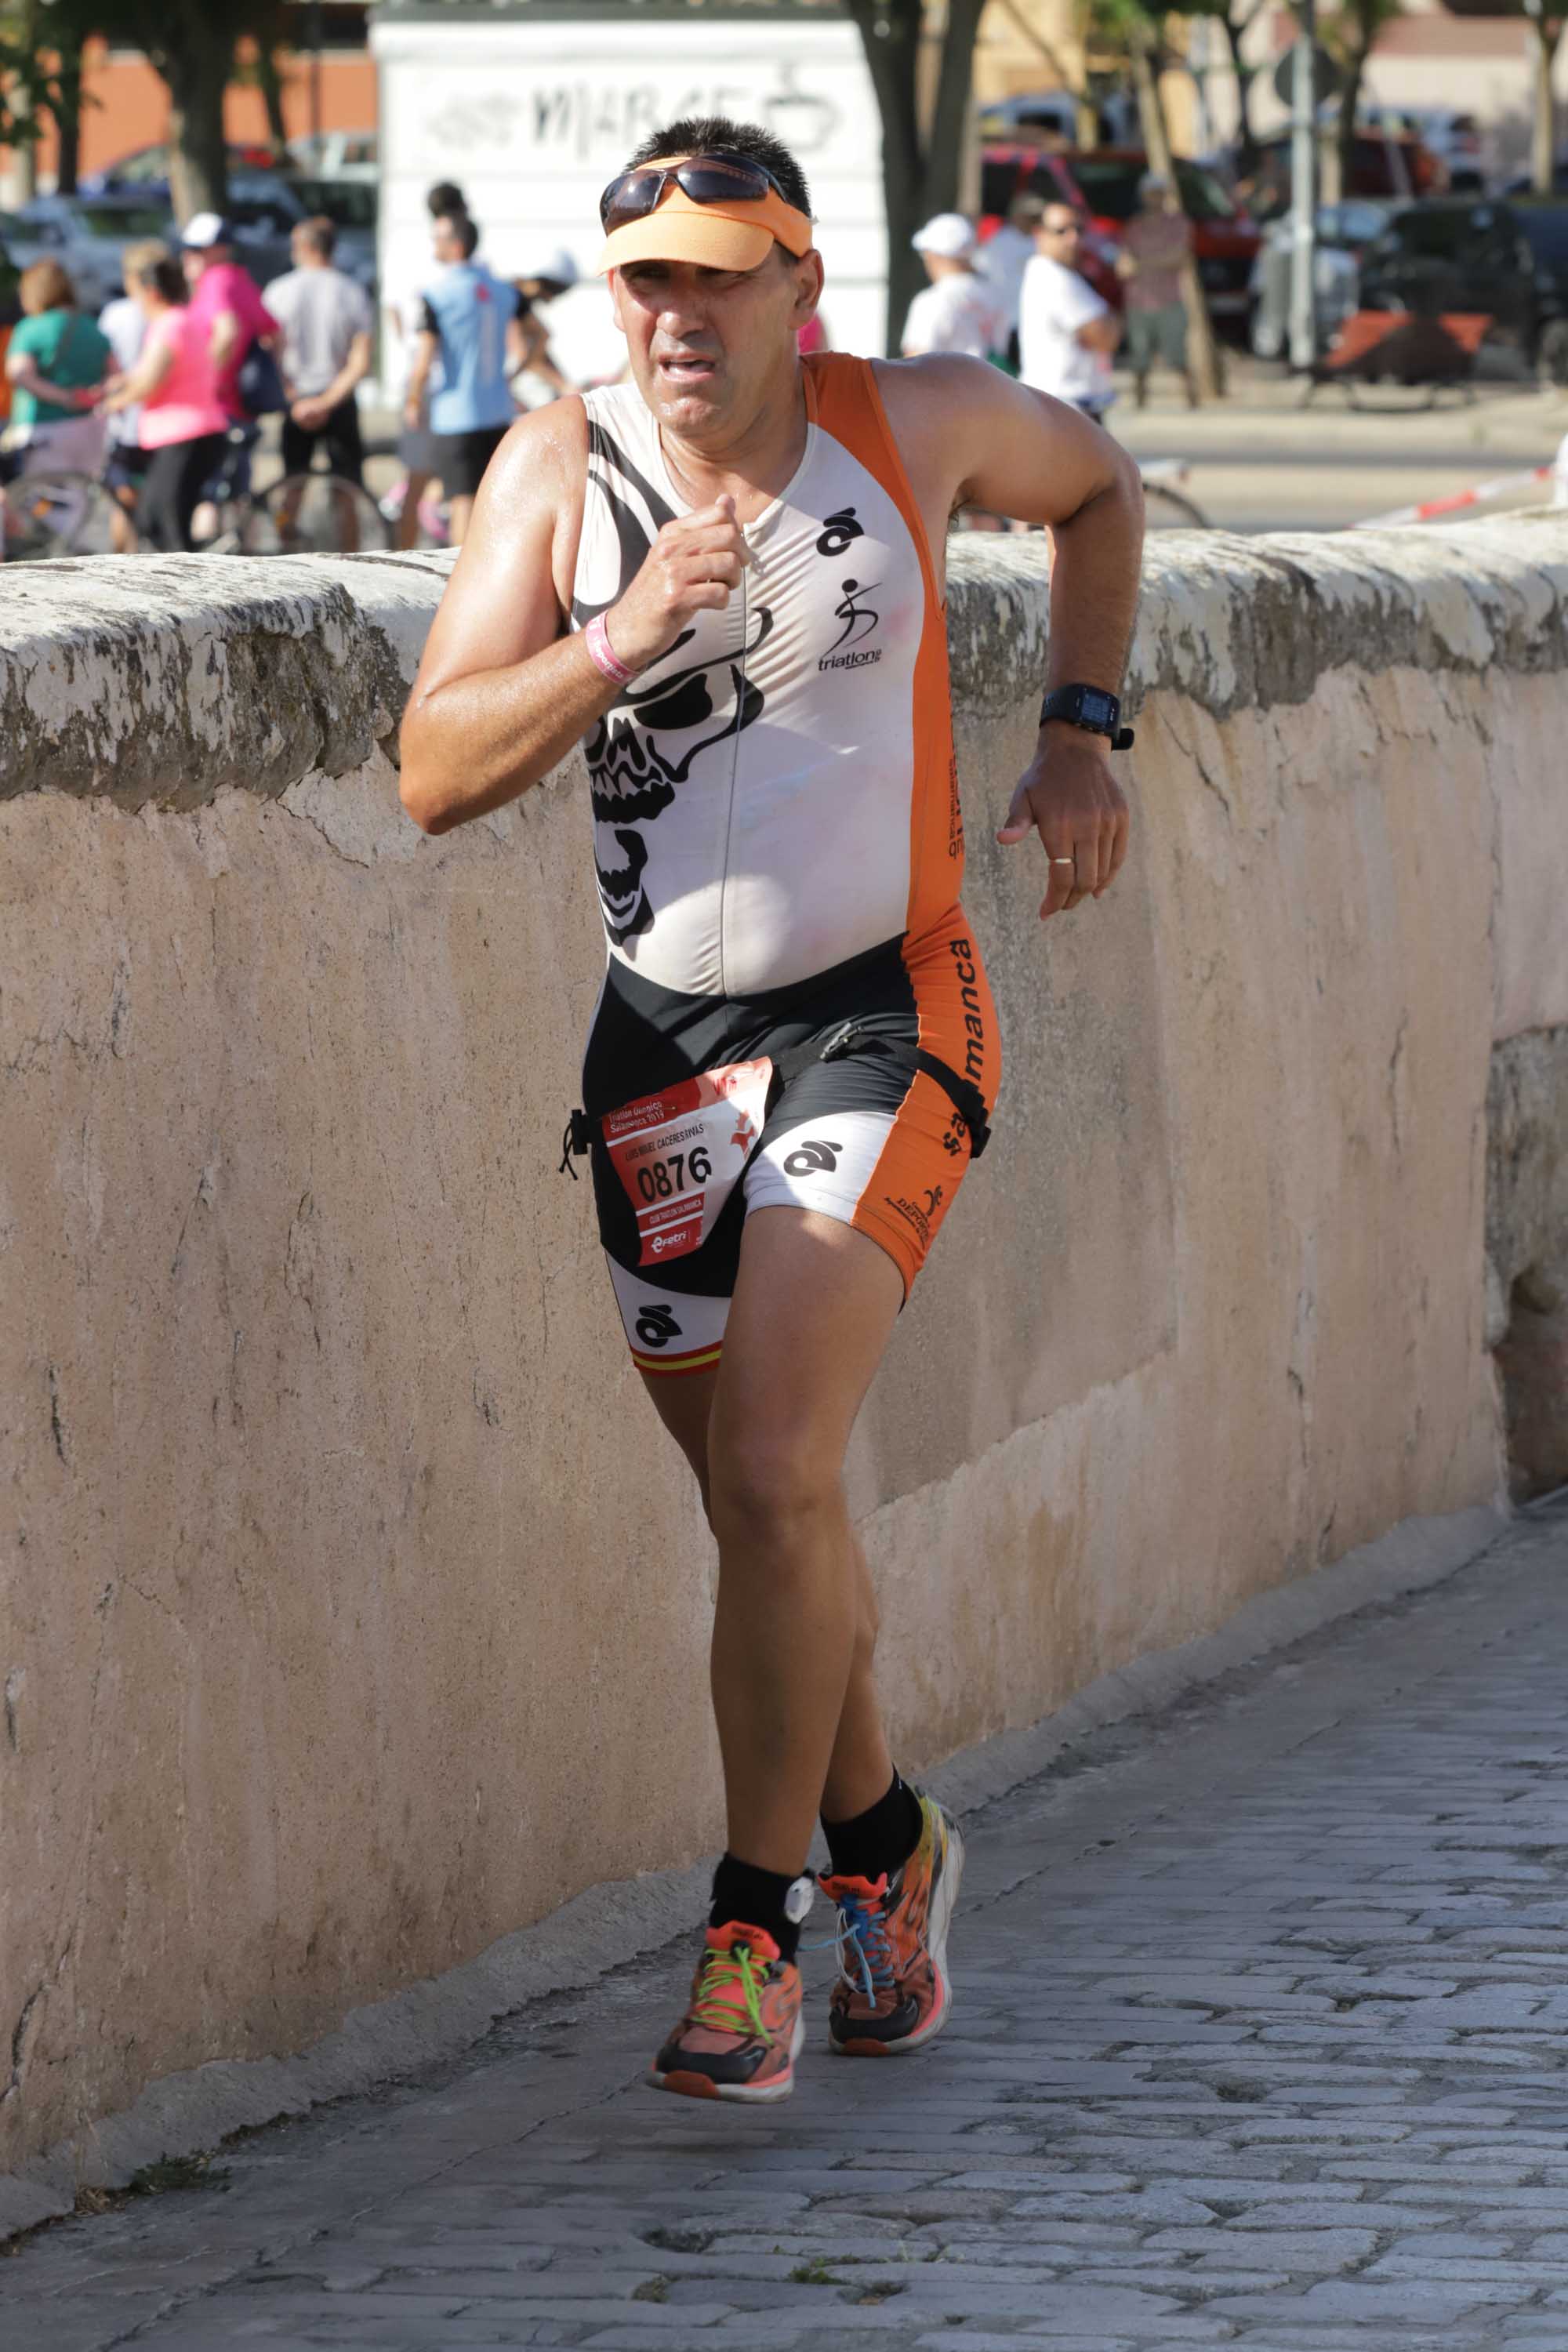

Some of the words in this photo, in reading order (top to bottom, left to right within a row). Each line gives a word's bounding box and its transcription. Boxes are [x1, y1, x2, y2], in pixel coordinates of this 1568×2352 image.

[818, 651, 876, 672] triatlon
[943, 937, 985, 1157] samanca
[657, 1131, 685, 1150] CACERES
[637, 1146, 712, 1203] 0876
